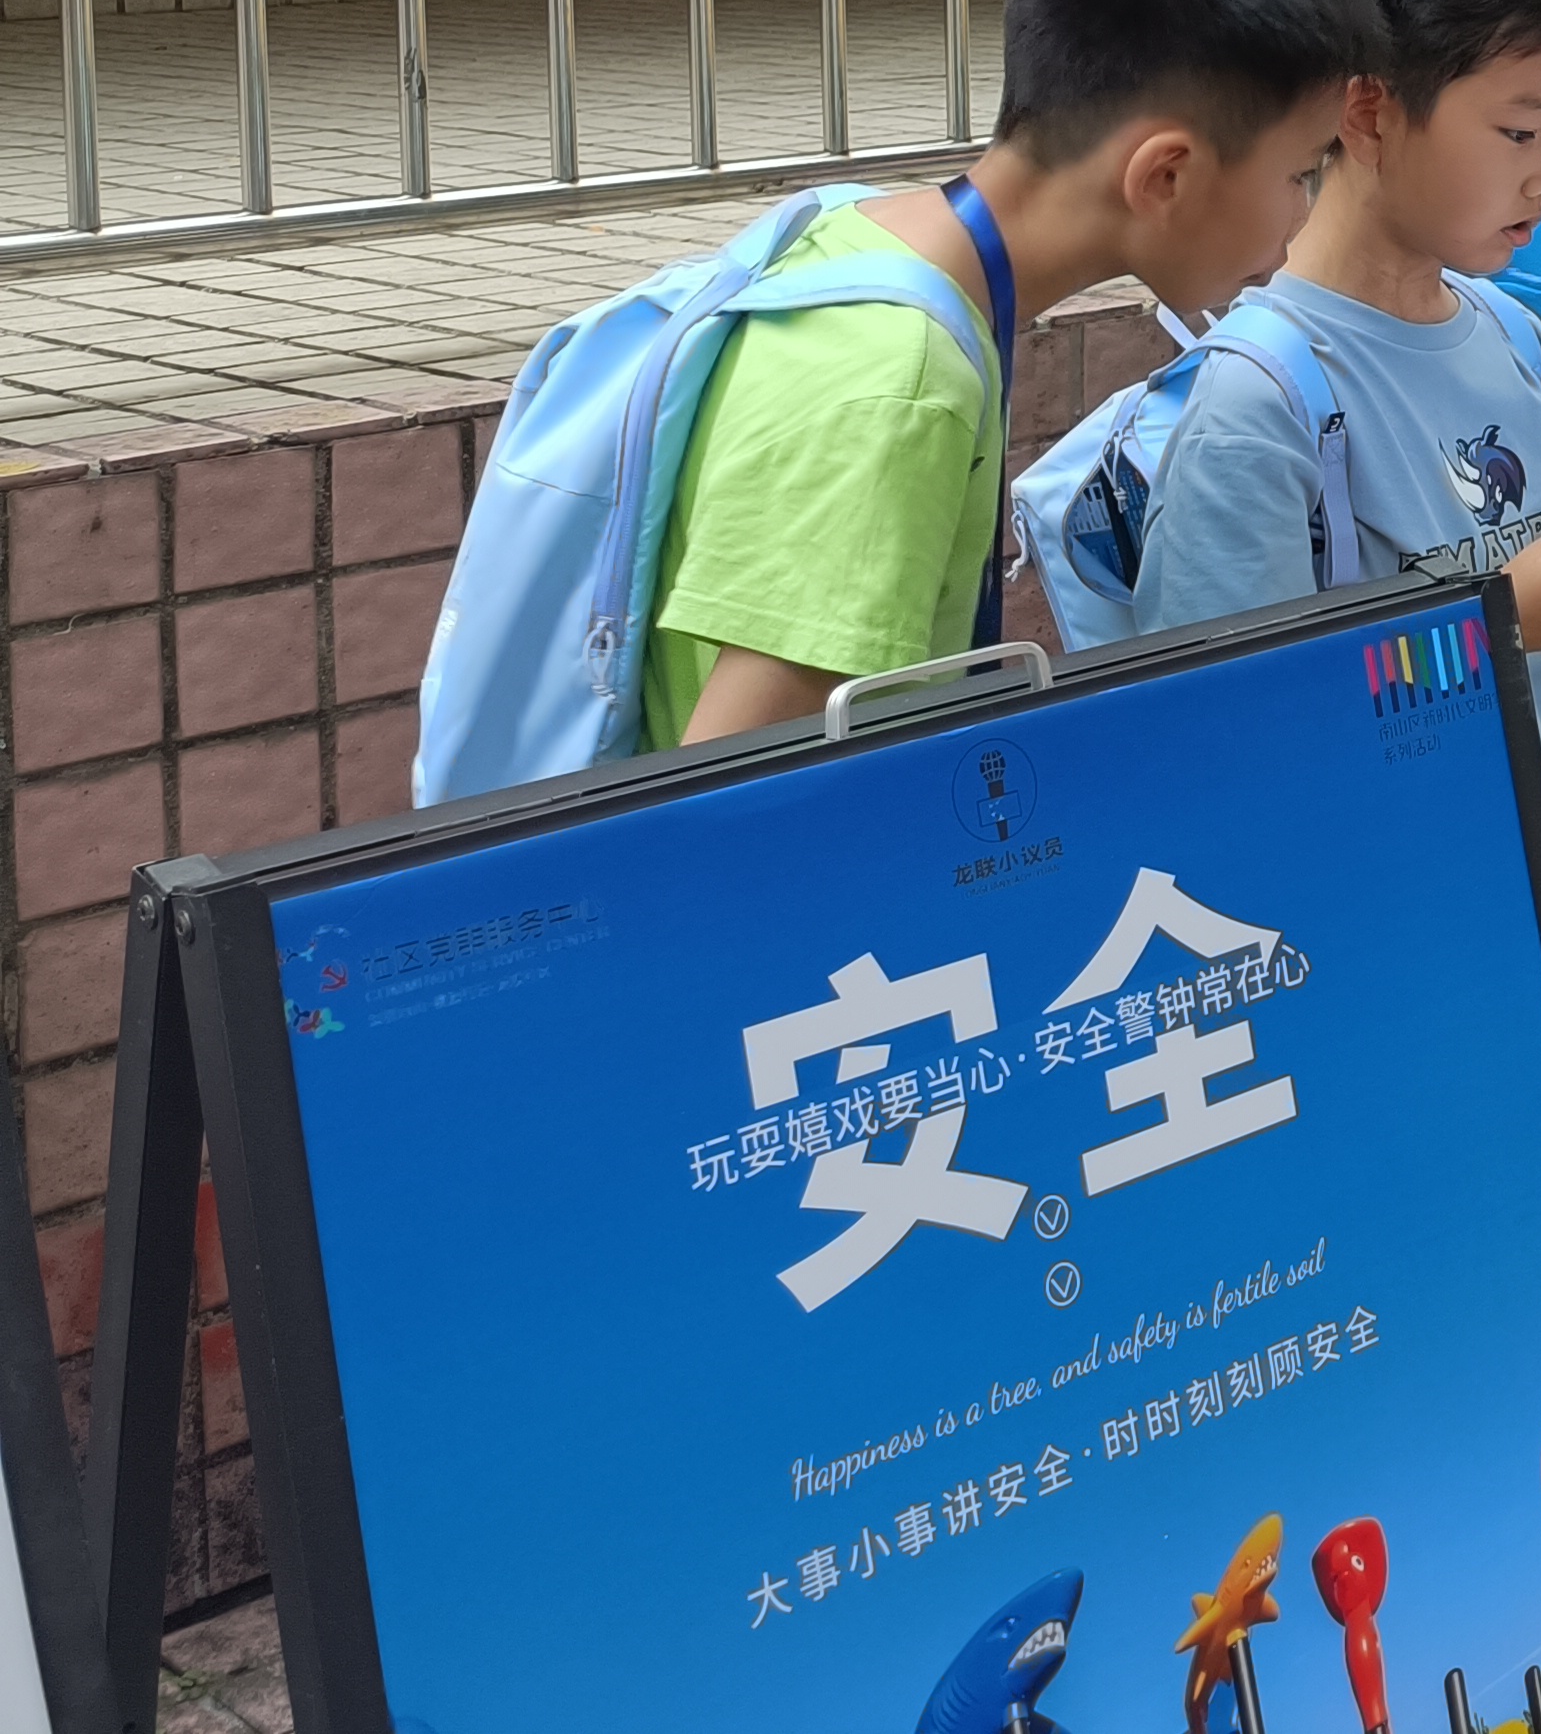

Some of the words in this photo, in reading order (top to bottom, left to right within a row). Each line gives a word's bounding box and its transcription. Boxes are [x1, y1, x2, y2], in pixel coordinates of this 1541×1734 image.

[1379, 693, 1499, 743] 南山区新时代文明
[1384, 733, 1440, 766] 系列活动
[952, 836, 1064, 888] 龙联小议员
[743, 866, 1298, 1314] 安全
[792, 1423, 928, 1502] Happiness
[933, 1406, 960, 1436] is
[964, 1401, 984, 1424] a
[1051, 1333, 1102, 1390] and
[1107, 1311, 1181, 1364] safety
[1185, 1301, 1207, 1328] is
[1212, 1263, 1281, 1329] fertile
[1285, 1237, 1326, 1286] soil
[747, 1304, 1382, 1630] 大事小事讲安全·时时刻刻顾安全
